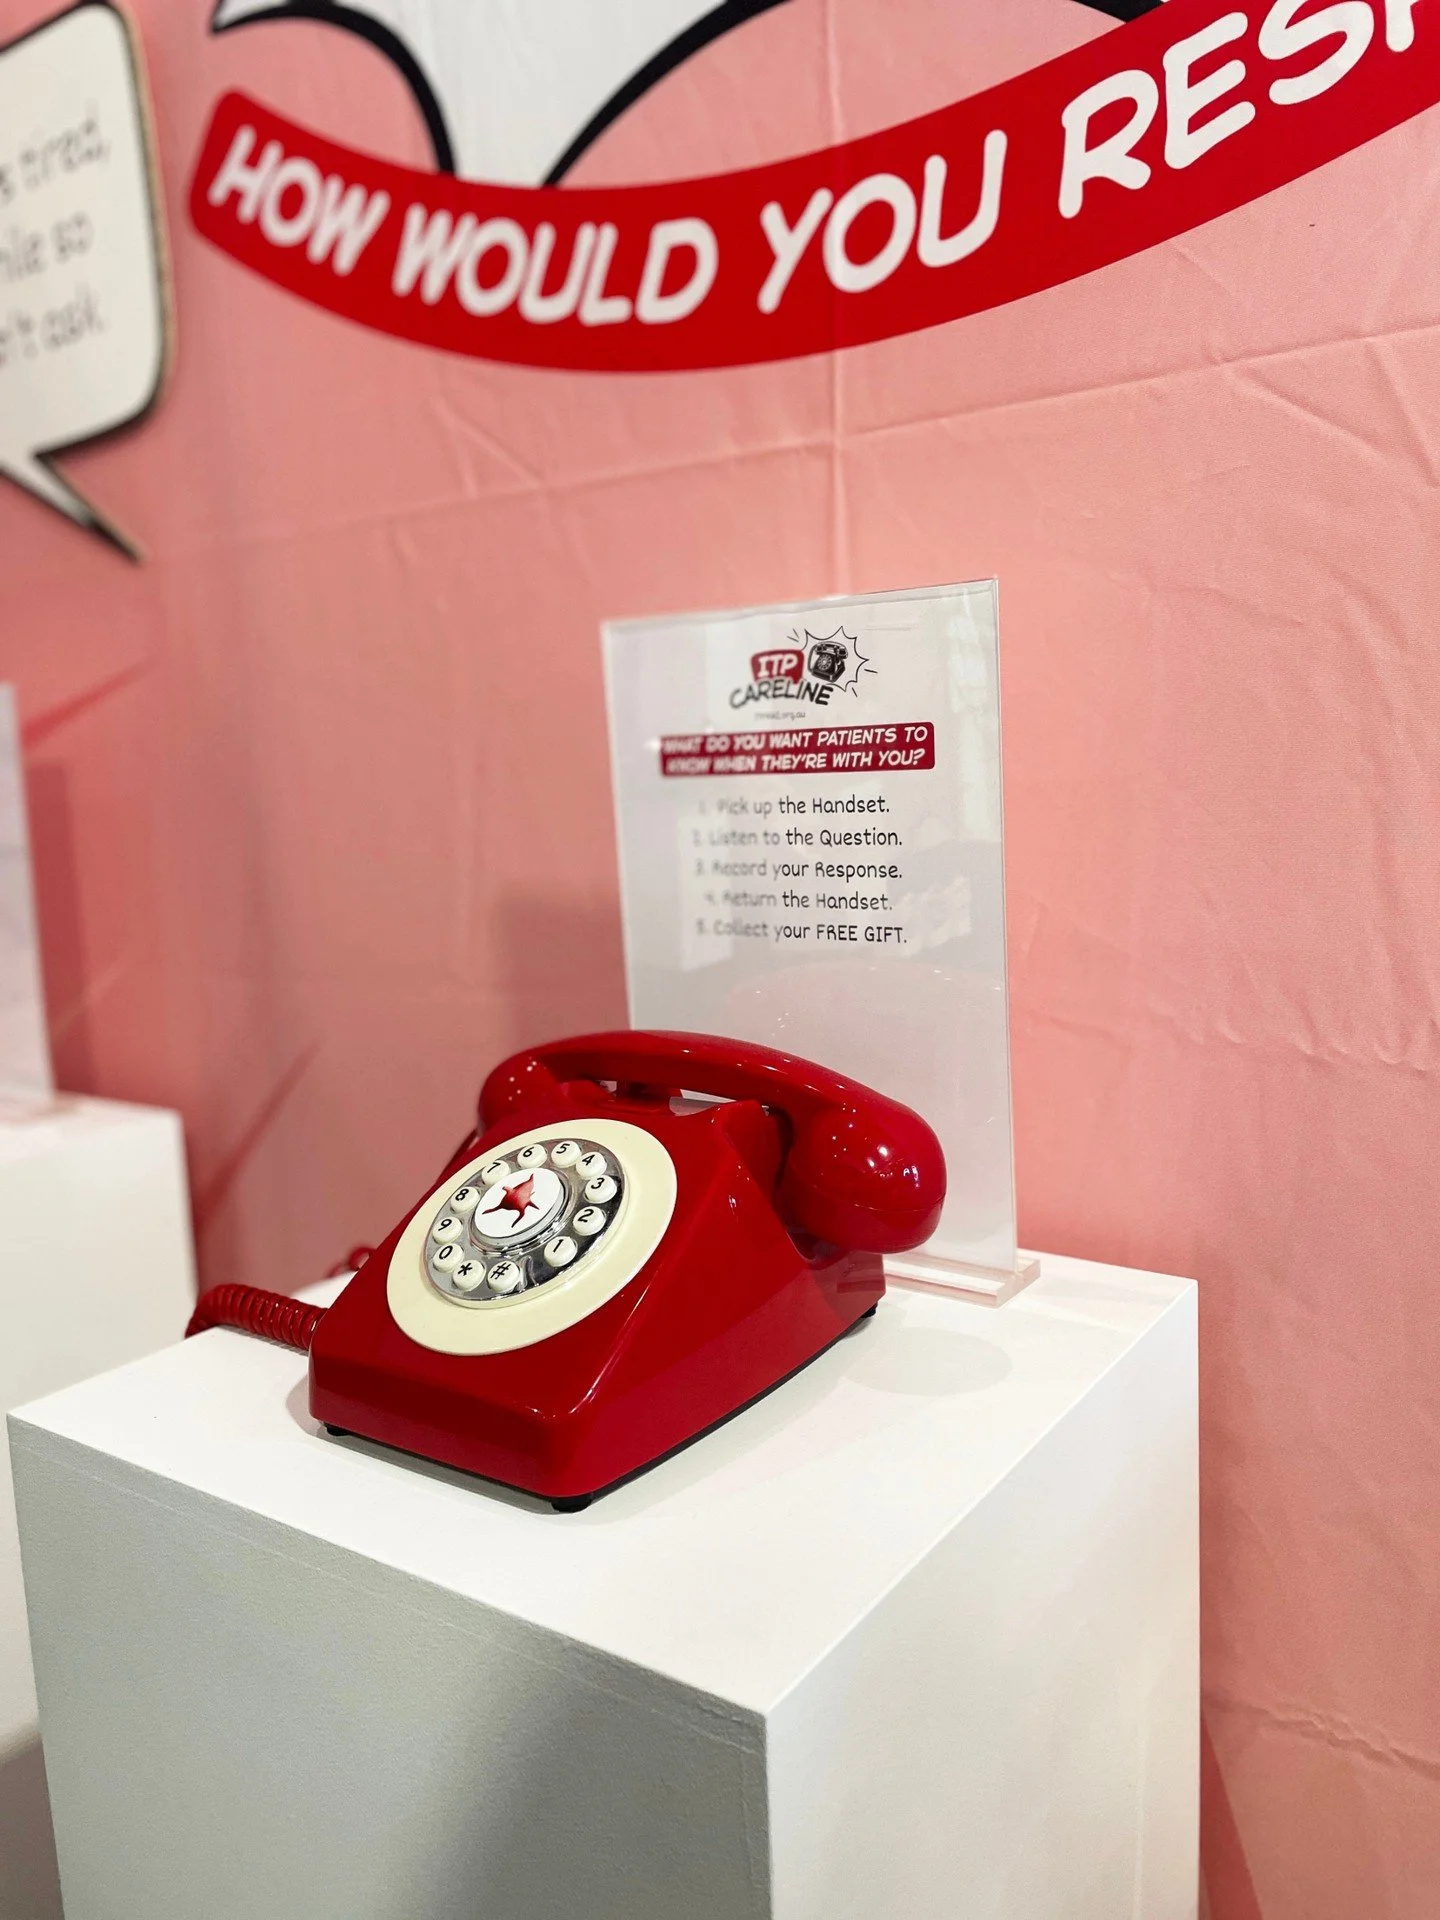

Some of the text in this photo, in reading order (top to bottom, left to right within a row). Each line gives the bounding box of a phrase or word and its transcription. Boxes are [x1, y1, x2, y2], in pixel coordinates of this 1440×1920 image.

[208, 125, 390, 276] HOW
[392, 203, 720, 326] WOULD
[757, 129, 1008, 314] YOU
[757, 652, 799, 678] ITP
[729, 677, 834, 709] CARELINE
[706, 735, 730, 753] DO
[734, 734, 766, 751] YOU
[768, 732, 811, 748] WANT
[817, 727, 898, 747] PATIENTS
[904, 726, 928, 742] TO
[713, 755, 756, 772] WHEN
[761, 752, 827, 771] THEY'RE
[832, 751, 873, 768] WITH
[878, 748, 926, 766] YOU?
[717, 797, 749, 815] Pick
[753, 800, 773, 819] up
[778, 795, 806, 814] the
[812, 794, 890, 814] Handset.
[707, 829, 758, 846] Listen
[763, 830, 781, 846] to
[786, 827, 813, 846] the
[820, 827, 903, 847] Question.
[711, 859, 768, 877] Record
[772, 862, 810, 881] your
[815, 861, 903, 883] Response.
[722, 890, 777, 907] Return
[782, 890, 810, 908] the
[815, 891, 893, 911] Handset.
[713, 918, 769, 937] Collect
[774, 924, 811, 943] your
[816, 924, 858, 942] FREE
[864, 926, 908, 944] GIFT.
[523, 1146, 533, 1158] 6
[557, 1143, 570, 1154] 5
[487, 1162, 501, 1173] 7
[582, 1154, 594, 1166] 4
[591, 1177, 604, 1190] 3
[455, 1188, 469, 1201] 8
[438, 1218, 452, 1232] 9
[578, 1209, 594, 1223] 2
[553, 1239, 564, 1253] 1
